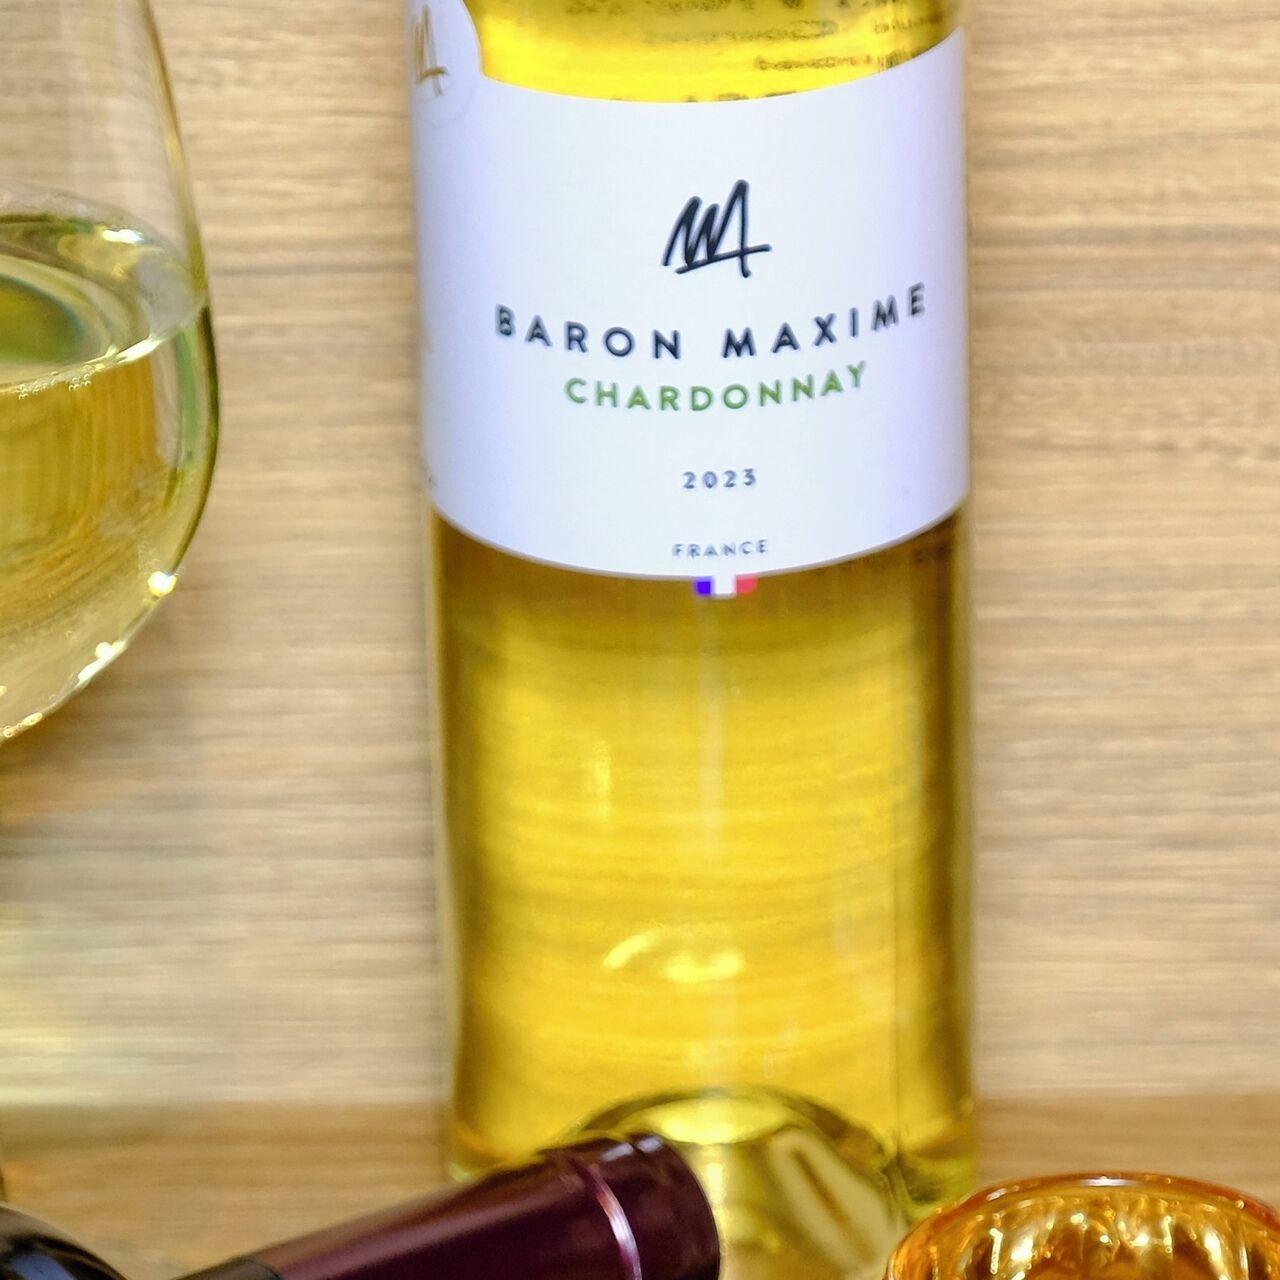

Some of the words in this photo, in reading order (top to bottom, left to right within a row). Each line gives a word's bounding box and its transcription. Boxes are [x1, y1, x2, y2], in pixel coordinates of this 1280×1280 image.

[495, 304, 683, 360] BARON
[721, 282, 927, 360] MAXIME
[564, 360, 868, 412] CHARDONNAY
[682, 468, 757, 490] 2023
[672, 539, 768, 558] FRANCE
